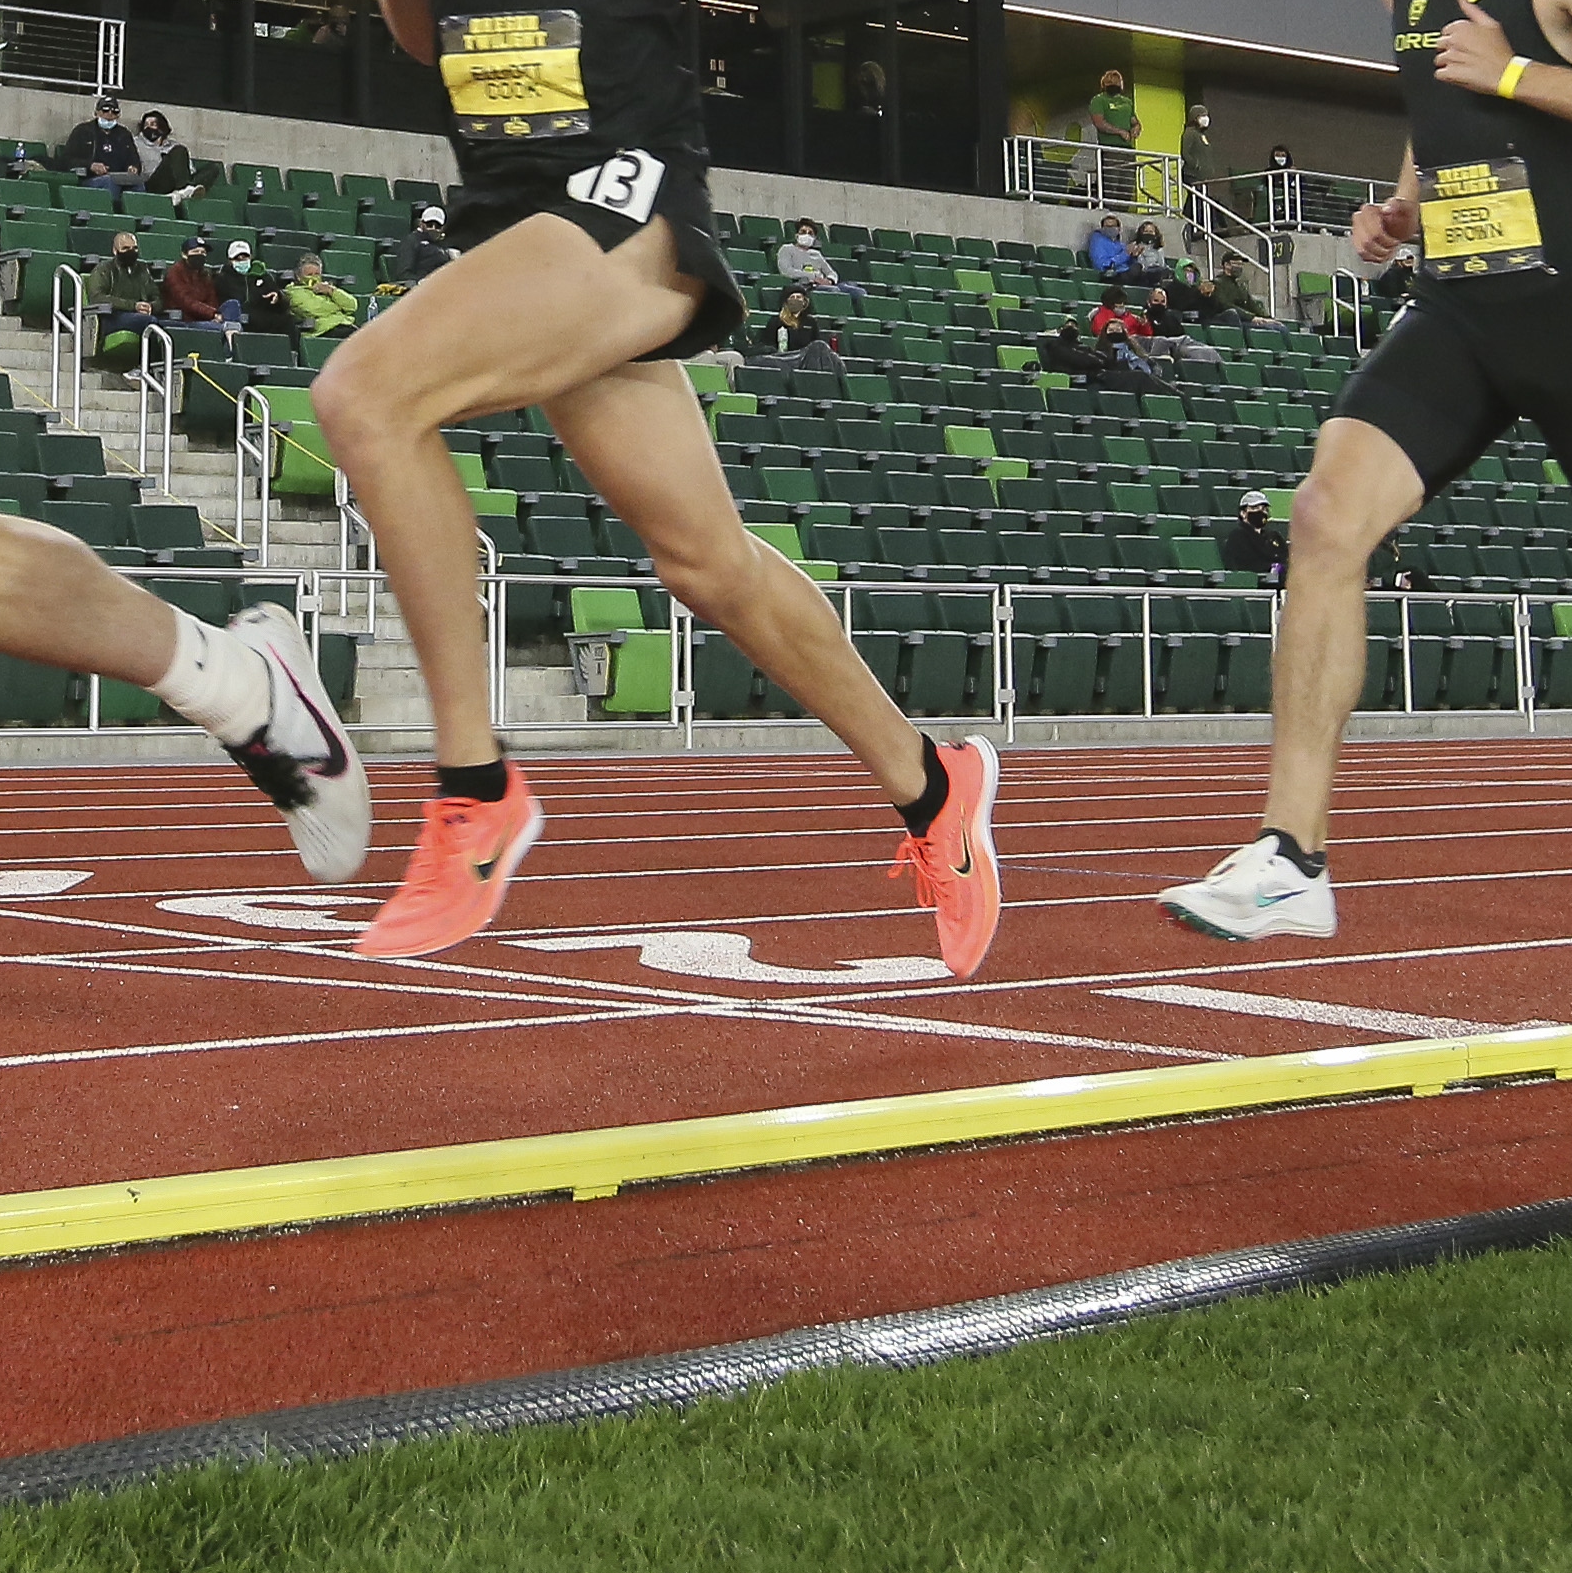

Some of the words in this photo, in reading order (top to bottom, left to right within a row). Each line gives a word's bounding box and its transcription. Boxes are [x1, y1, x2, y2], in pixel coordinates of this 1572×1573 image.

[1394, 31, 1441, 52] ORE
[588, 155, 642, 209] 13
[1452, 206, 1490, 224] REED
[1445, 223, 1504, 244] BROWN
